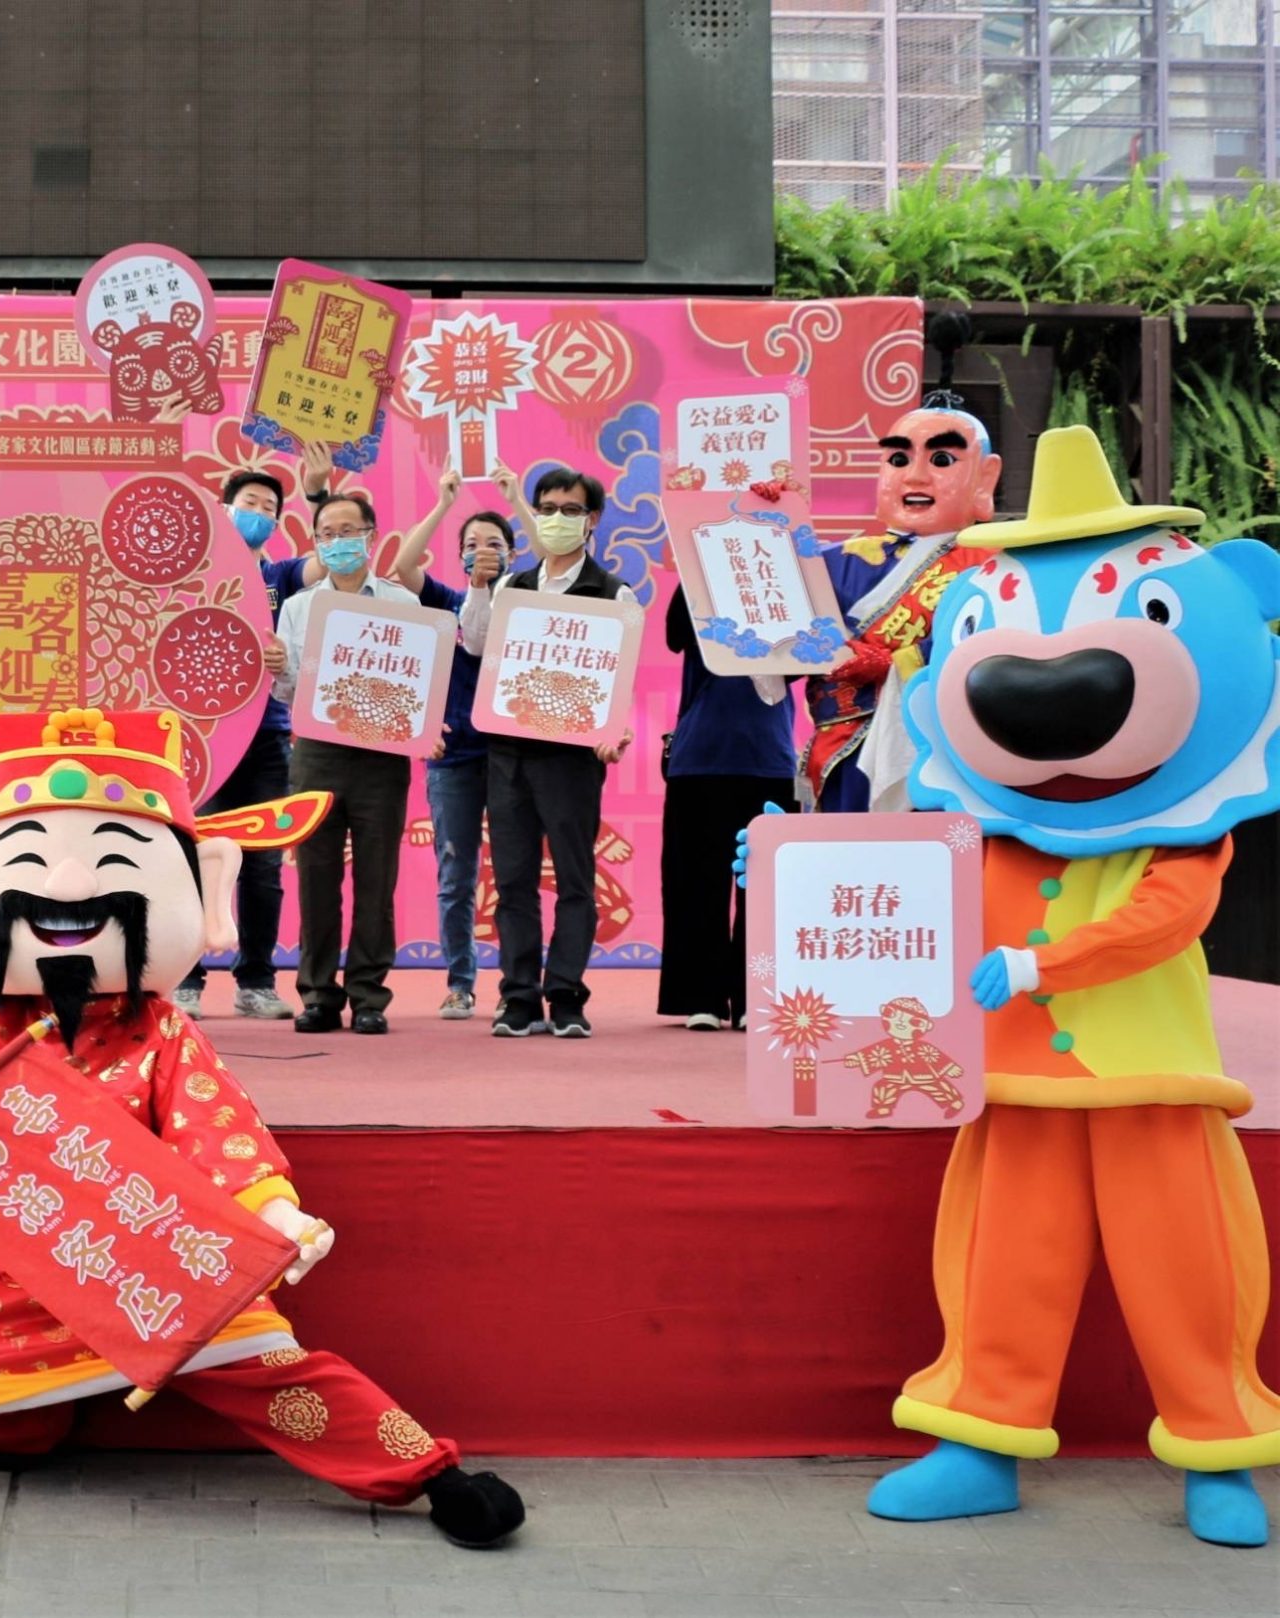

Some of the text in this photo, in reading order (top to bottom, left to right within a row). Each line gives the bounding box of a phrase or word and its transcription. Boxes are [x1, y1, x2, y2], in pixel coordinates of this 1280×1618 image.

[455, 341, 488, 357] 恭喜
[562, 343, 598, 378] 2
[455, 369, 488, 385] 發財
[689, 403, 780, 428] 公益愛心
[701, 430, 767, 454] 義賣會
[723, 537, 764, 625] 影像藝術展
[752, 538, 792, 623] 人在六堆
[359, 621, 404, 648] 六堆
[543, 615, 588, 642] 美拍
[332, 643, 422, 679] 新春市集
[503, 639, 619, 673] 百日草花海
[830, 884, 902, 918] 新春
[795, 927, 937, 961] 精彩演出
